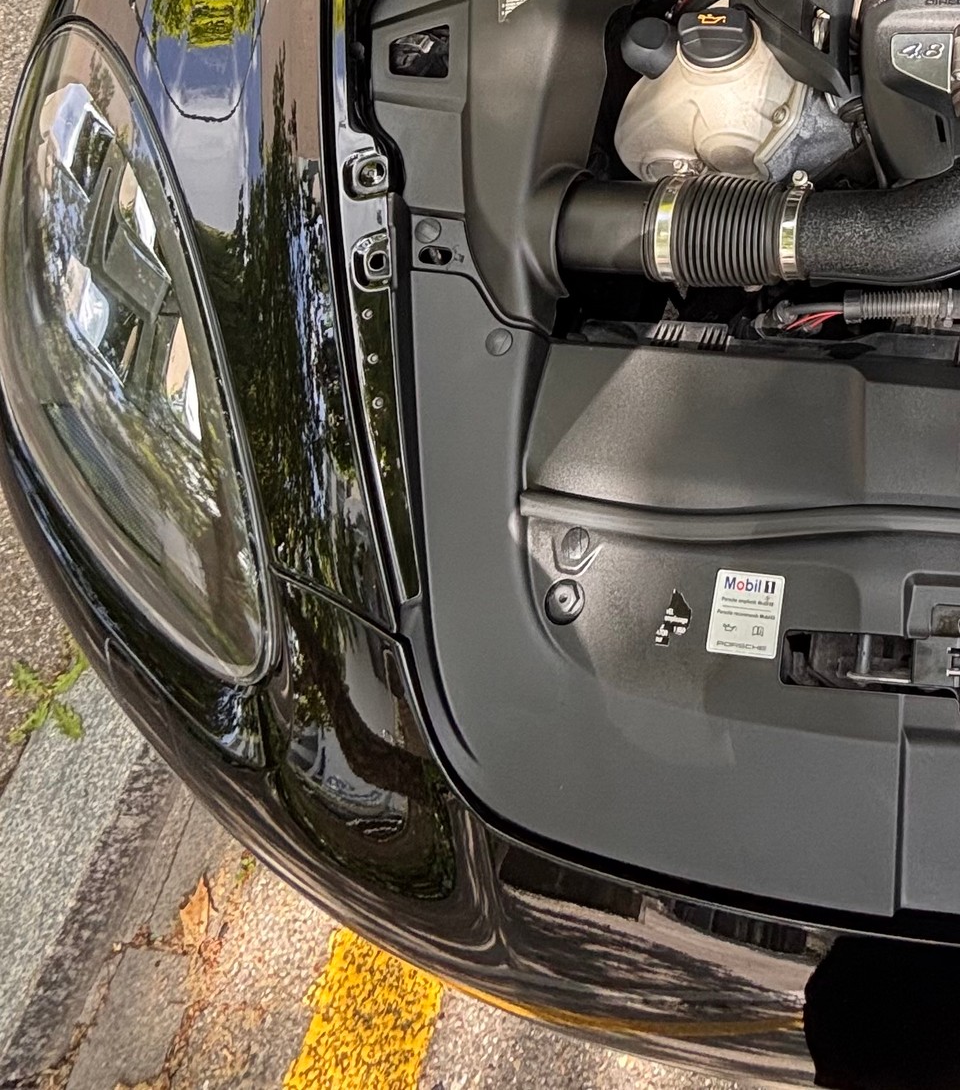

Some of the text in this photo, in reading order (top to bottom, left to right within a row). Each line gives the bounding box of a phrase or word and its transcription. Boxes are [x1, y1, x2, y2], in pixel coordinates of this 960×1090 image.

[897, 41, 945, 59] 4.8
[724, 576, 776, 594] Mobil 1
[716, 640, 767, 651] PORSCHE
